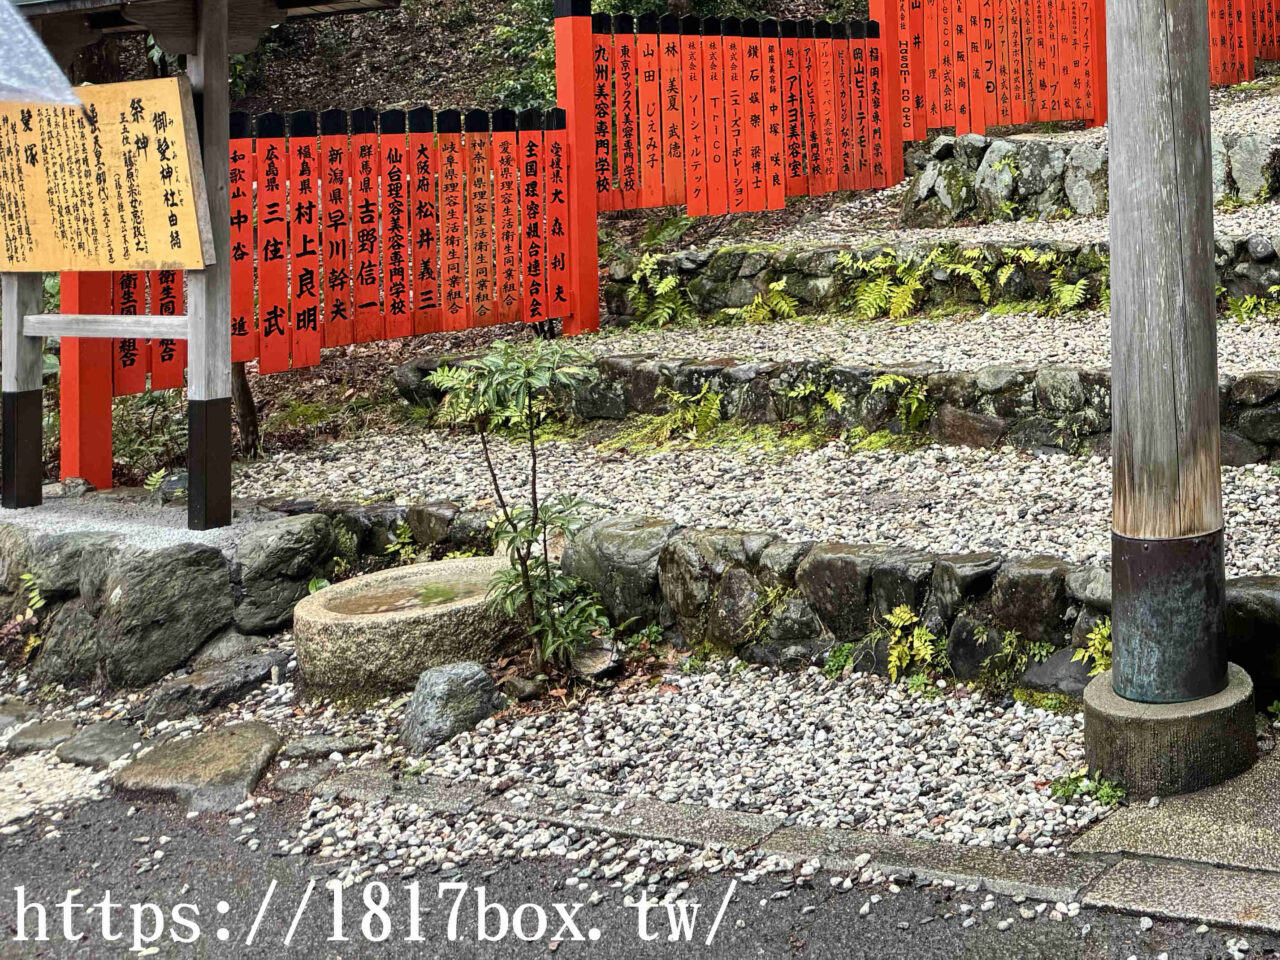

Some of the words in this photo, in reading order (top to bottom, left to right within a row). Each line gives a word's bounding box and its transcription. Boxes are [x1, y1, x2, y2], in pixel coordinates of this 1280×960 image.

[594, 44, 611, 193] 九州美容専門学校
[620, 44, 636, 192] 東京マックス美容専門学校
[386, 147, 407, 316] 仙台理容美容専門学校
[441, 141, 464, 315] 岐阜県理容生活衛生同業組合
[471, 138, 492, 317] 神奈川県理容生活衛生同業組合
[499, 140, 518, 307] 愛媛県理容生活衛生同業組合
[524, 140, 543, 318] 全国理容組合連合会
